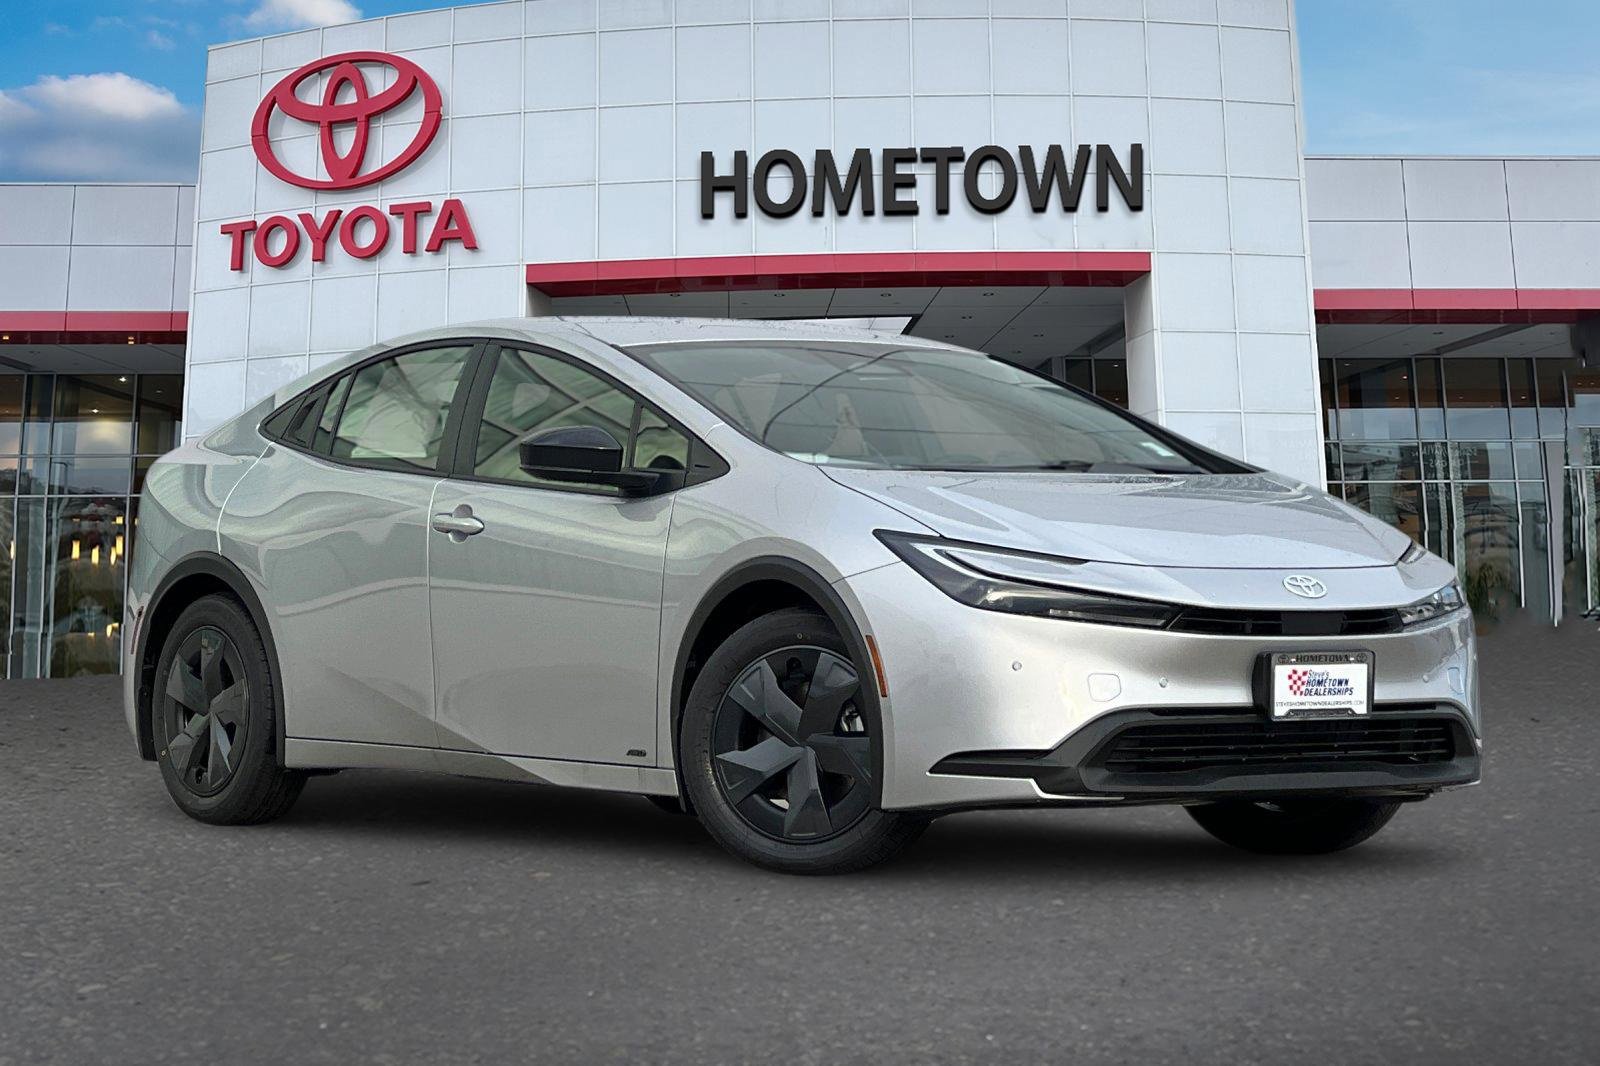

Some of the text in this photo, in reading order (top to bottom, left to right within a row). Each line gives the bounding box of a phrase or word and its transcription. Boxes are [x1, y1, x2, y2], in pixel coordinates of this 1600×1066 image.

[700, 143, 1144, 219] HOMETOWN
[220, 198, 479, 271] TOYOTA
[1296, 654, 1350, 663] HOMETOWN
[1308, 669, 1329, 679] Steve's
[1306, 678, 1349, 687] HOMETOWN
[1304, 687, 1354, 696] DEALERSHIPS
